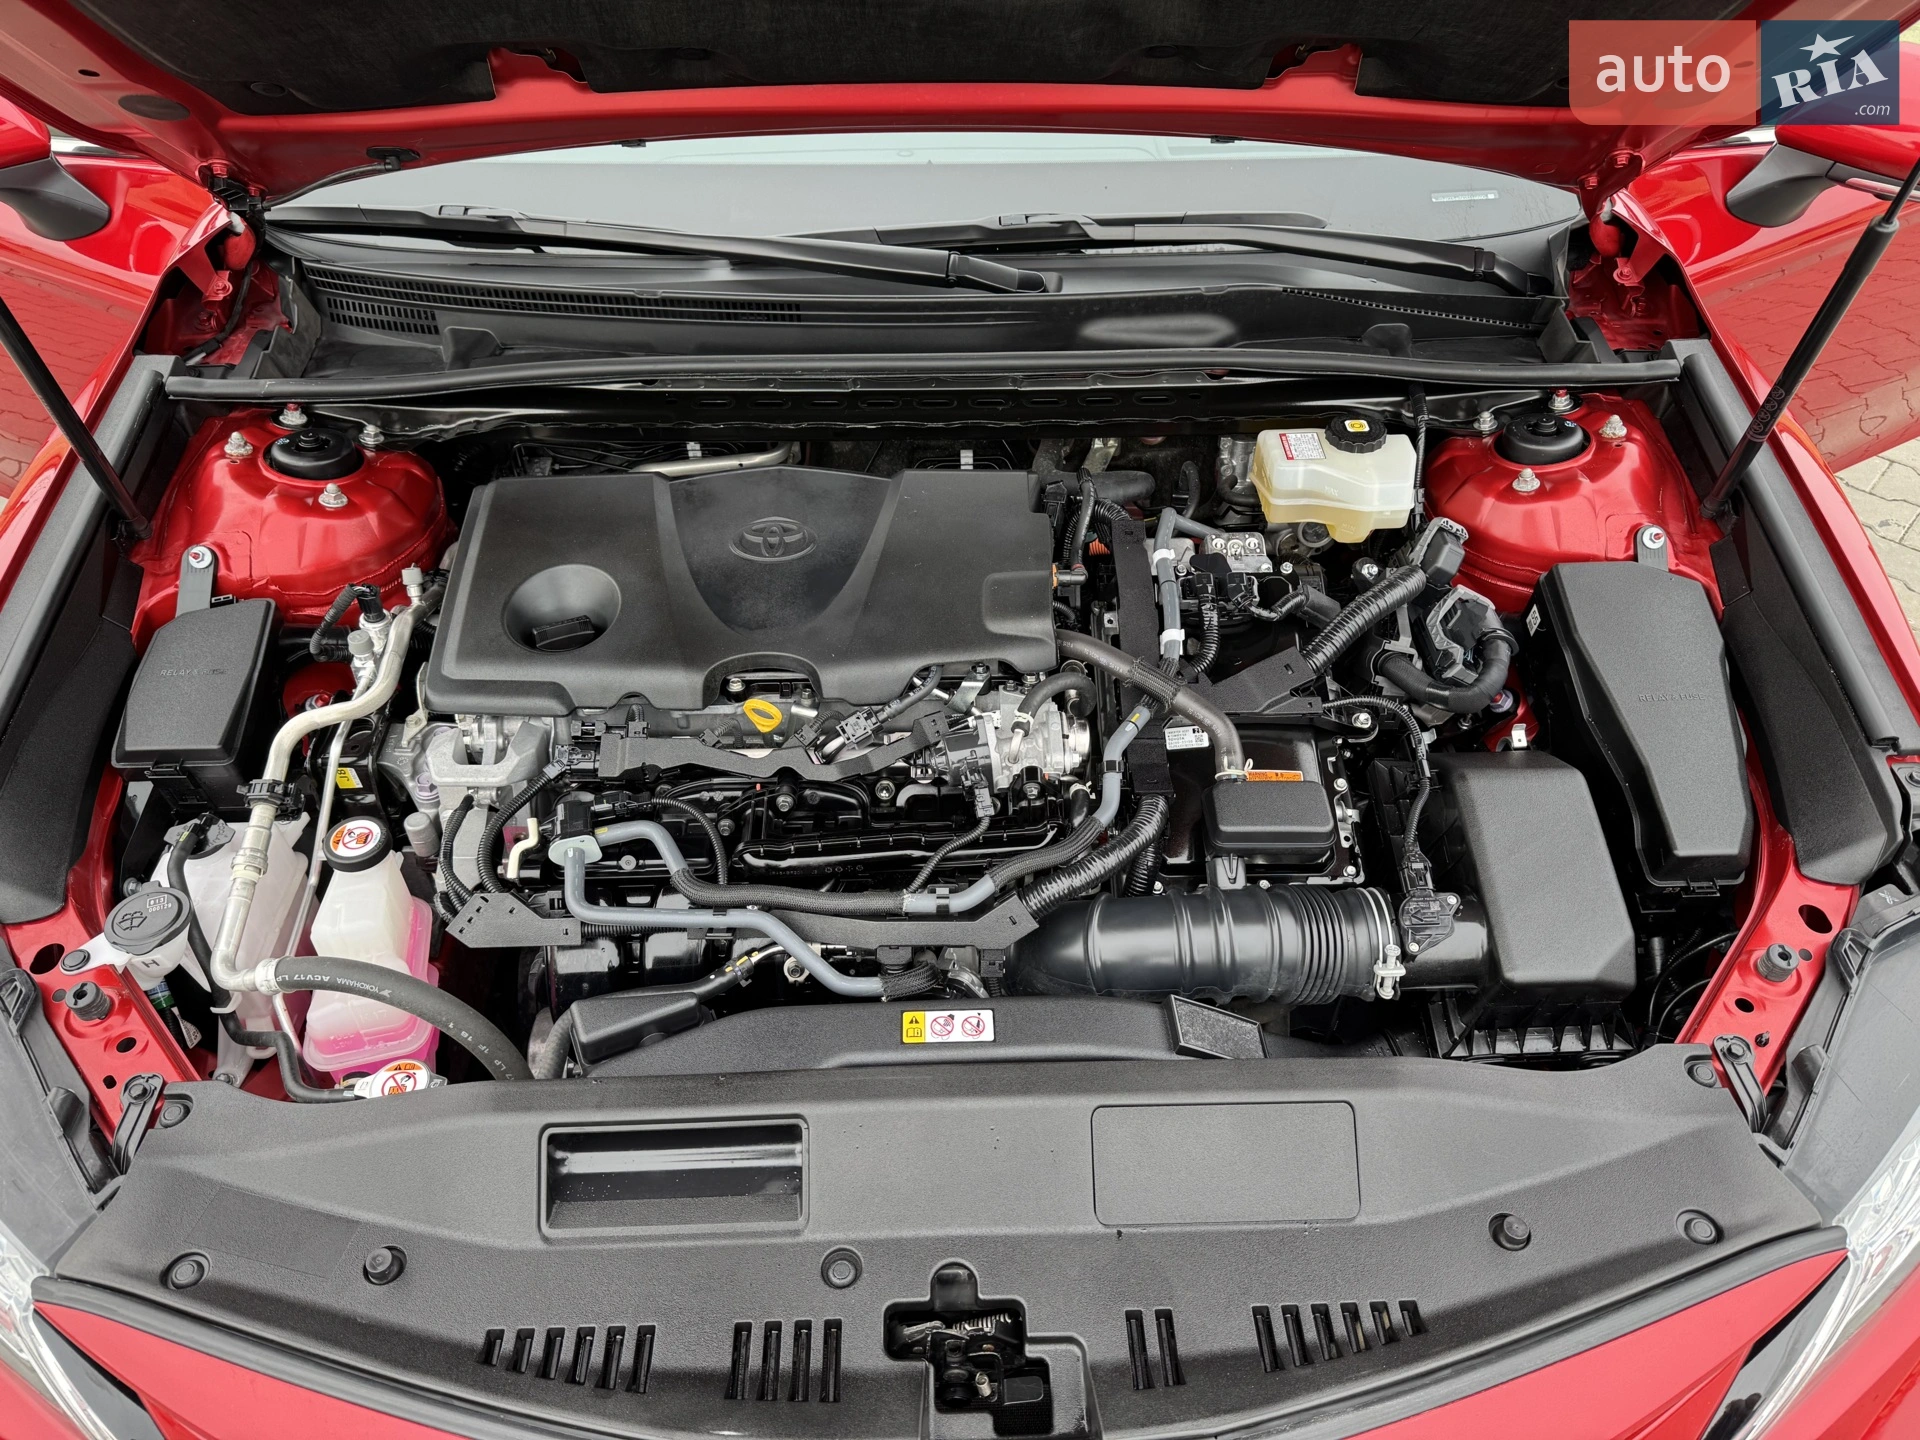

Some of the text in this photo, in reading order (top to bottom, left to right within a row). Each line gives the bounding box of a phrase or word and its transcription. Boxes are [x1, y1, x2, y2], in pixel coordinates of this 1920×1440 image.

[160, 668, 191, 676] RELAY
[1638, 693, 1668, 702] RELAY
[1679, 692, 1706, 701] FUSE
[293, 974, 331, 982] ACV17
[336, 977, 380, 993] YOKOHAMA
